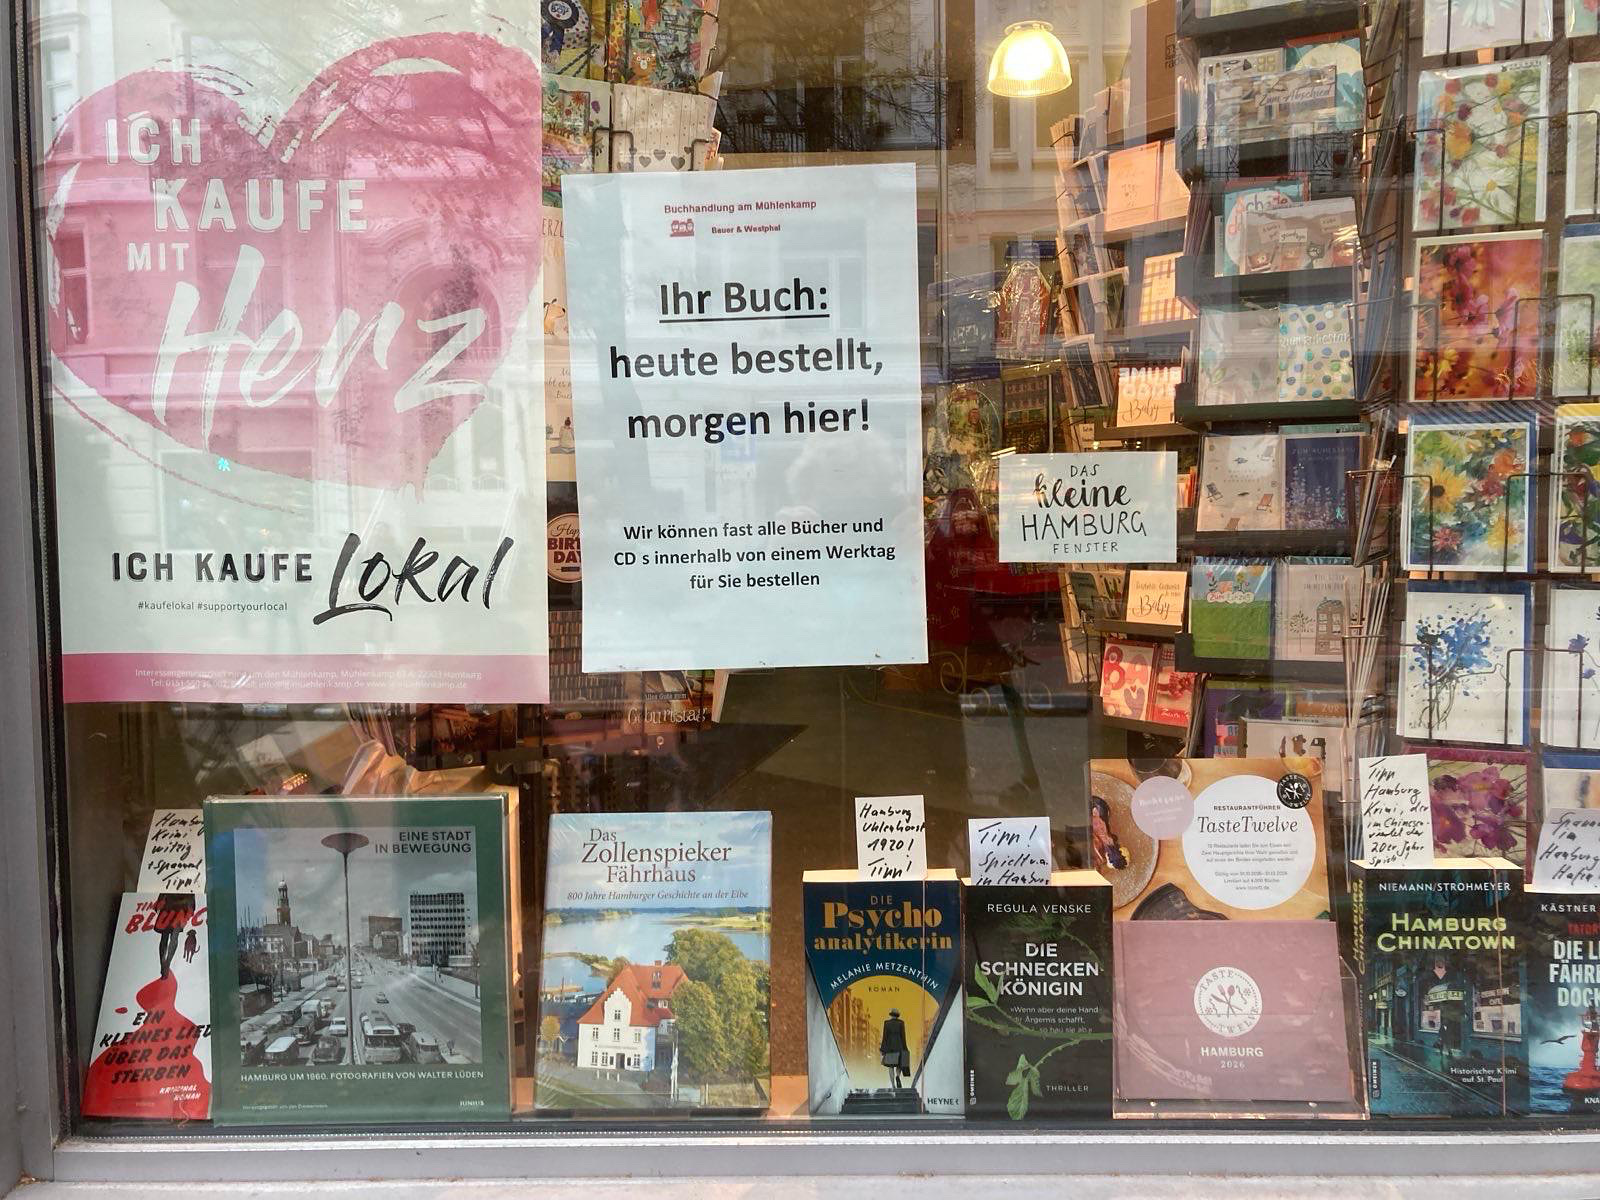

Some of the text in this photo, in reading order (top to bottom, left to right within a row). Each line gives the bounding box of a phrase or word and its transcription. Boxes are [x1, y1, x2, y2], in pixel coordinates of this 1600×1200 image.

[105, 117, 202, 166] ICH
[153, 177, 368, 233] KAUFE
[664, 200, 817, 214] Buchhandlung am Mühlenkamp
[711, 226, 734, 234] Bauer
[744, 224, 781, 234] Westphal
[127, 242, 190, 271] MIT
[660, 278, 828, 315] Ihr Buch:
[151, 244, 488, 452] Herz
[610, 345, 718, 379] heute
[731, 337, 883, 376] bestellt,
[628, 398, 870, 444] morgen hier!
[1070, 464, 1100, 477] DAS
[1034, 472, 1131, 508] kleine
[623, 518, 884, 540] Wir können fast alle Bücher und
[1021, 511, 1147, 541] HAMBURG
[613, 543, 896, 566] CD s innerhalb von einem Werktag
[1053, 541, 1119, 554] FENSTER
[111, 552, 174, 581] ICH
[196, 551, 313, 582] KAUFE
[690, 571, 820, 590] für Sie bestellen
[137, 600, 288, 614] #kaufelokal #supportyourlocal
[859, 803, 912, 823] Hamburg
[1197, 815, 1299, 833] TasteTwelve
[399, 830, 472, 841] EINE STADT
[589, 828, 617, 842] Das
[375, 842, 472, 854] IN BEWEGUNG
[581, 840, 732, 869] Zollenspieker
[606, 863, 696, 883] Fährhaus
[567, 891, 584, 901] 800
[585, 891, 607, 901] Jahre
[608, 891, 655, 902] Hamburger
[657, 890, 701, 900] Geschichte
[714, 890, 729, 899] der
[730, 890, 749, 899] Elbe
[1379, 882, 1511, 892] NIEMANN/STROHMEYER
[870, 895, 893, 906] DIE
[987, 903, 1092, 914] REGULA VENSKE
[1541, 902, 1597, 913] KÄSTNER
[124, 906, 208, 935] BLUNC
[823, 901, 943, 936] Psycho
[813, 932, 953, 955] analytikerin
[1025, 942, 1058, 957] DIE
[1553, 940, 1584, 960] DIE
[830, 962, 939, 990] MELANIE METZENTHIN
[980, 961, 1099, 977] SCHNECKEN
[1000, 978, 1083, 996] KÖNIGIN
[1200, 968, 1235, 992] TASTE
[132, 1010, 165, 1026] EIN
[1057, 1016, 1086, 1024] schafft,
[100, 1027, 173, 1048] KLEINES
[104, 1044, 192, 1066] ÜBER DAS
[1200, 1046, 1264, 1057] HAMBURG
[1220, 1060, 1245, 1069] 2026
[1450, 1067, 1517, 1075] Historischer Krimi
[111, 1064, 191, 1084] STERBEN
[240, 1073, 288, 1081] HAMBURG
[306, 1072, 329, 1080] 1960.
[330, 1071, 394, 1080] FOTOGRAFIEN
[395, 1071, 416, 1079] VON
[417, 1071, 455, 1079] WALTER
[455, 1069, 484, 1079] LÜDEN
[1462, 1075, 1474, 1083] auf
[1477, 1075, 1487, 1083] St.
[927, 1097, 955, 1105] HEYNE
